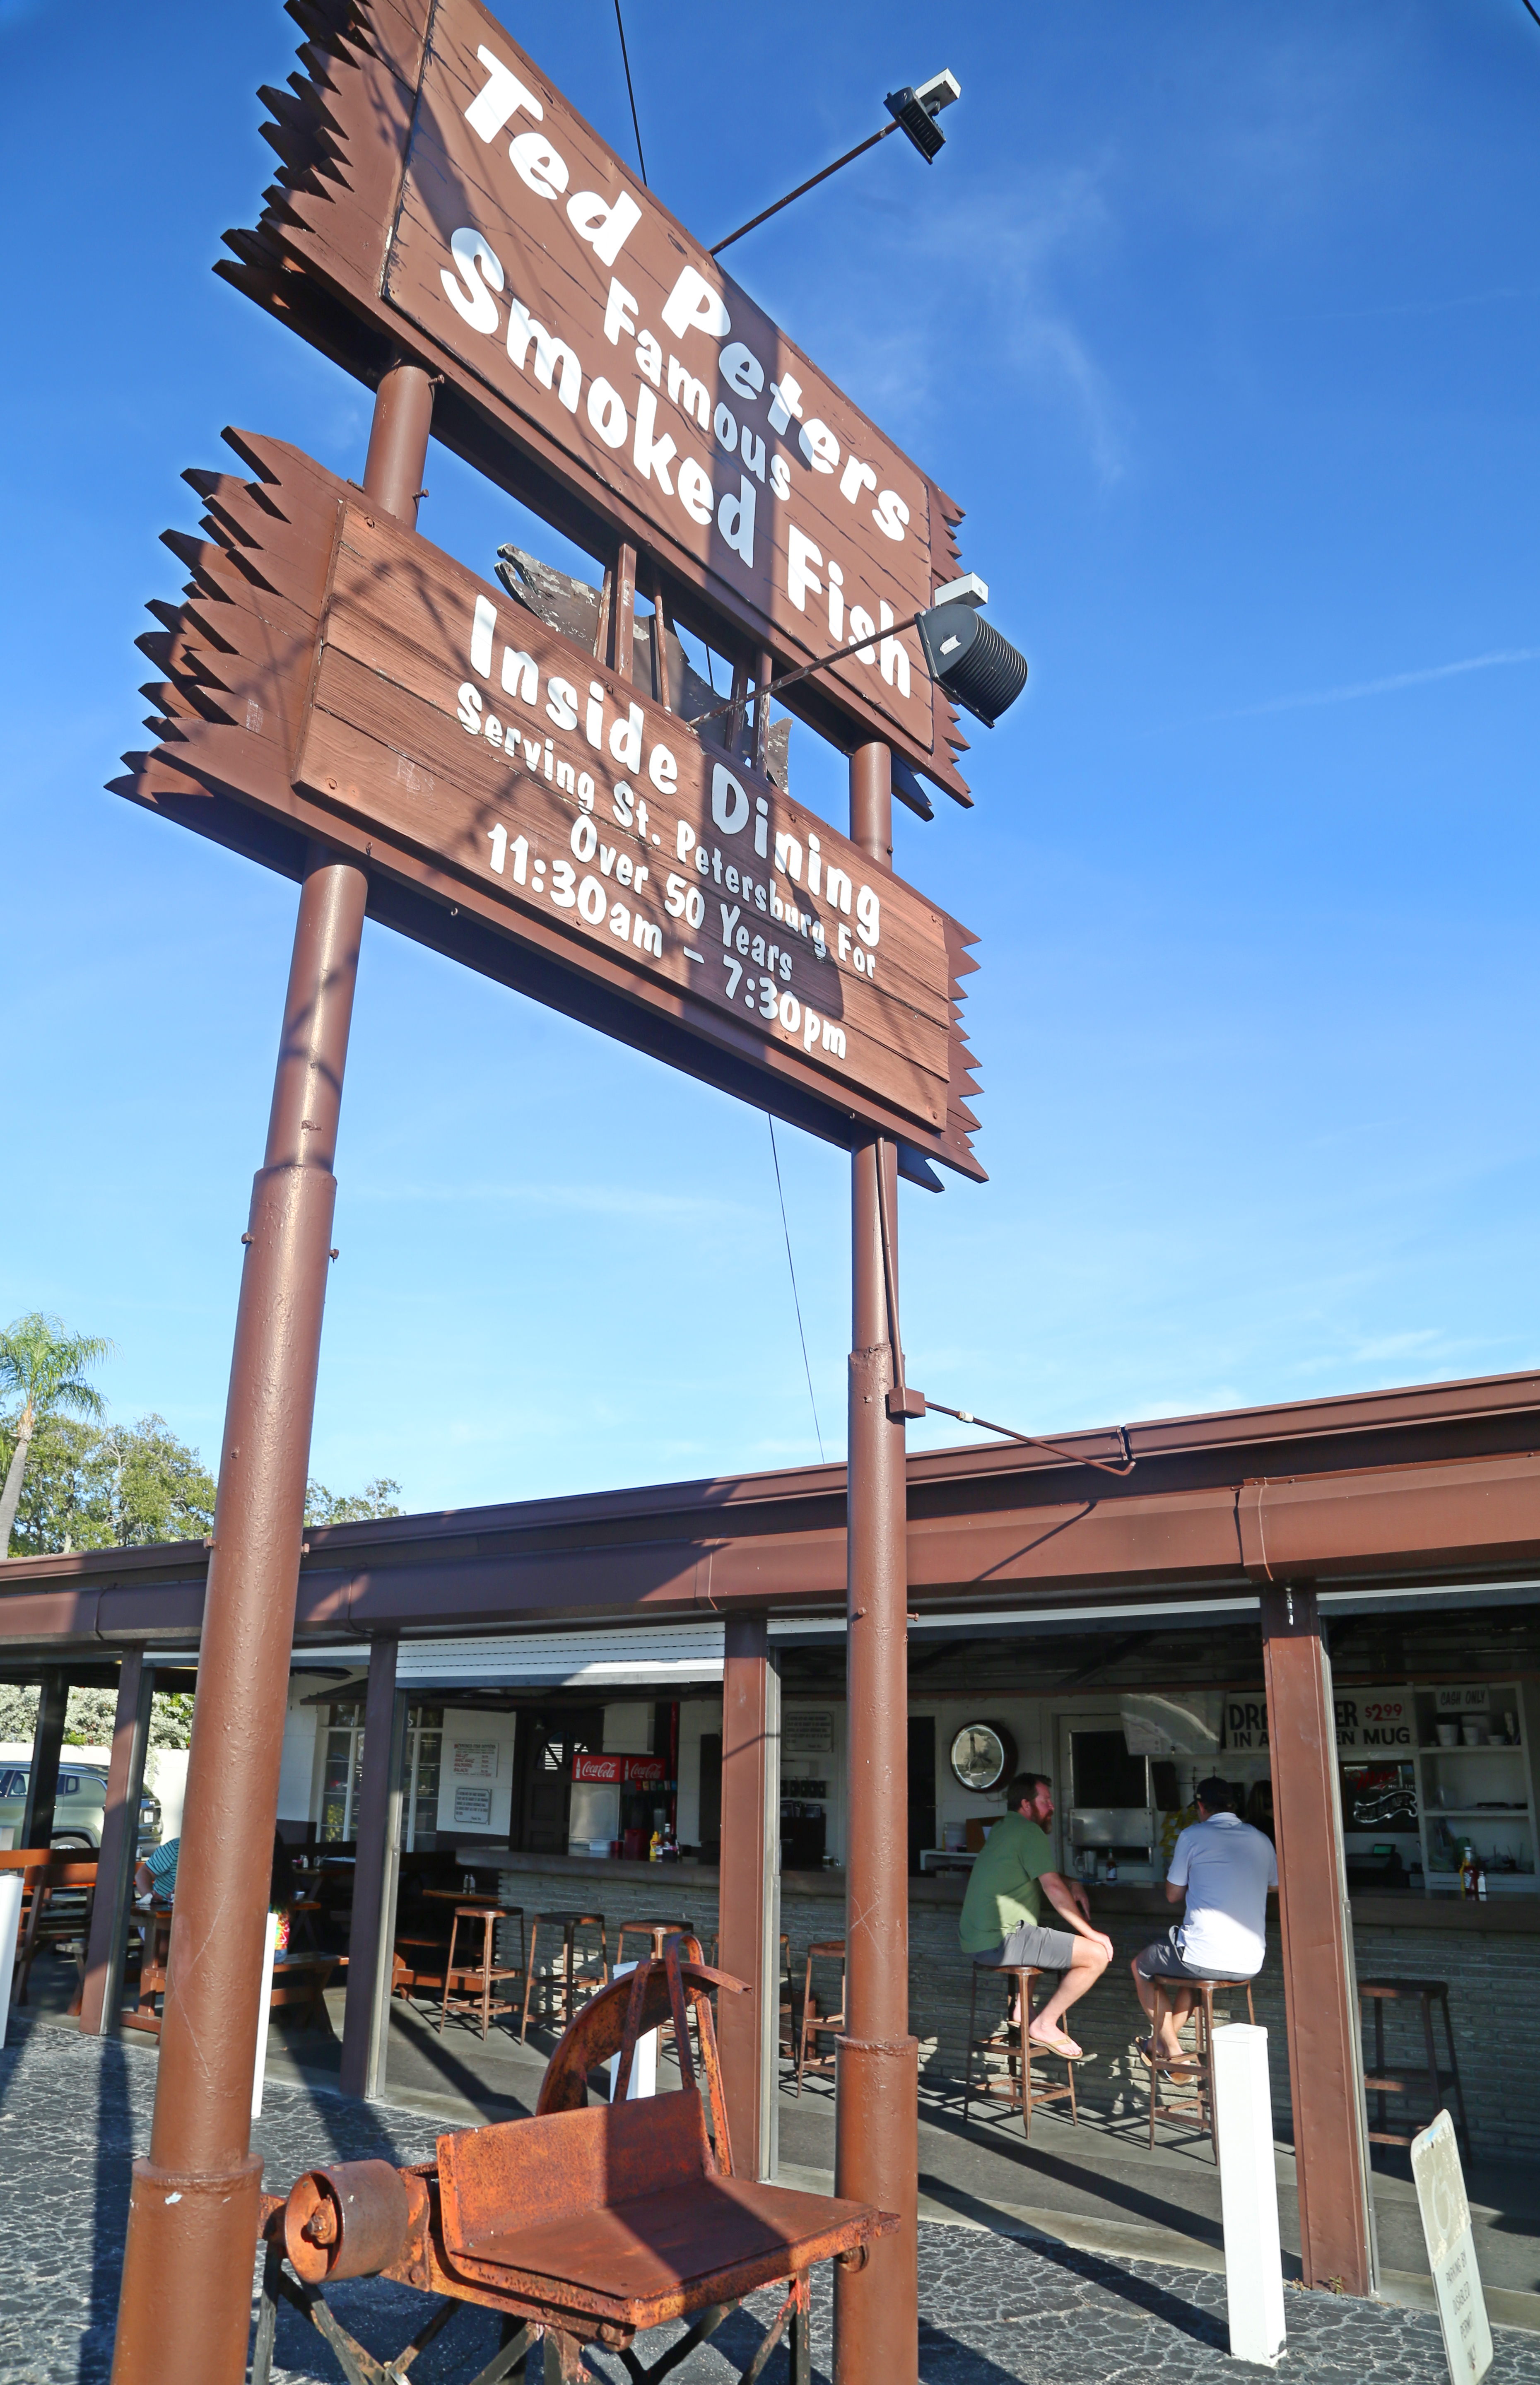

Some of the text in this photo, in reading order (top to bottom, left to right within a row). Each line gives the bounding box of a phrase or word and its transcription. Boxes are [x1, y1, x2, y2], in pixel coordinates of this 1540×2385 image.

[464, 44, 910, 542] Ted Peters
[603, 276, 790, 501] Famous
[440, 227, 911, 699] Smoked Fish
[457, 682, 876, 979] Serving St. Petersburg For
[470, 595, 881, 948] Inside Dining
[487, 822, 663, 959] 11:30am
[723, 954, 847, 1060] 7:30pm
[570, 814, 793, 981] Over 50 Years
[1234, 1732, 1252, 1747] IN
[1363, 1727, 1411, 1745] MUG
[1440, 1689, 1486, 1706] CASH ONLY
